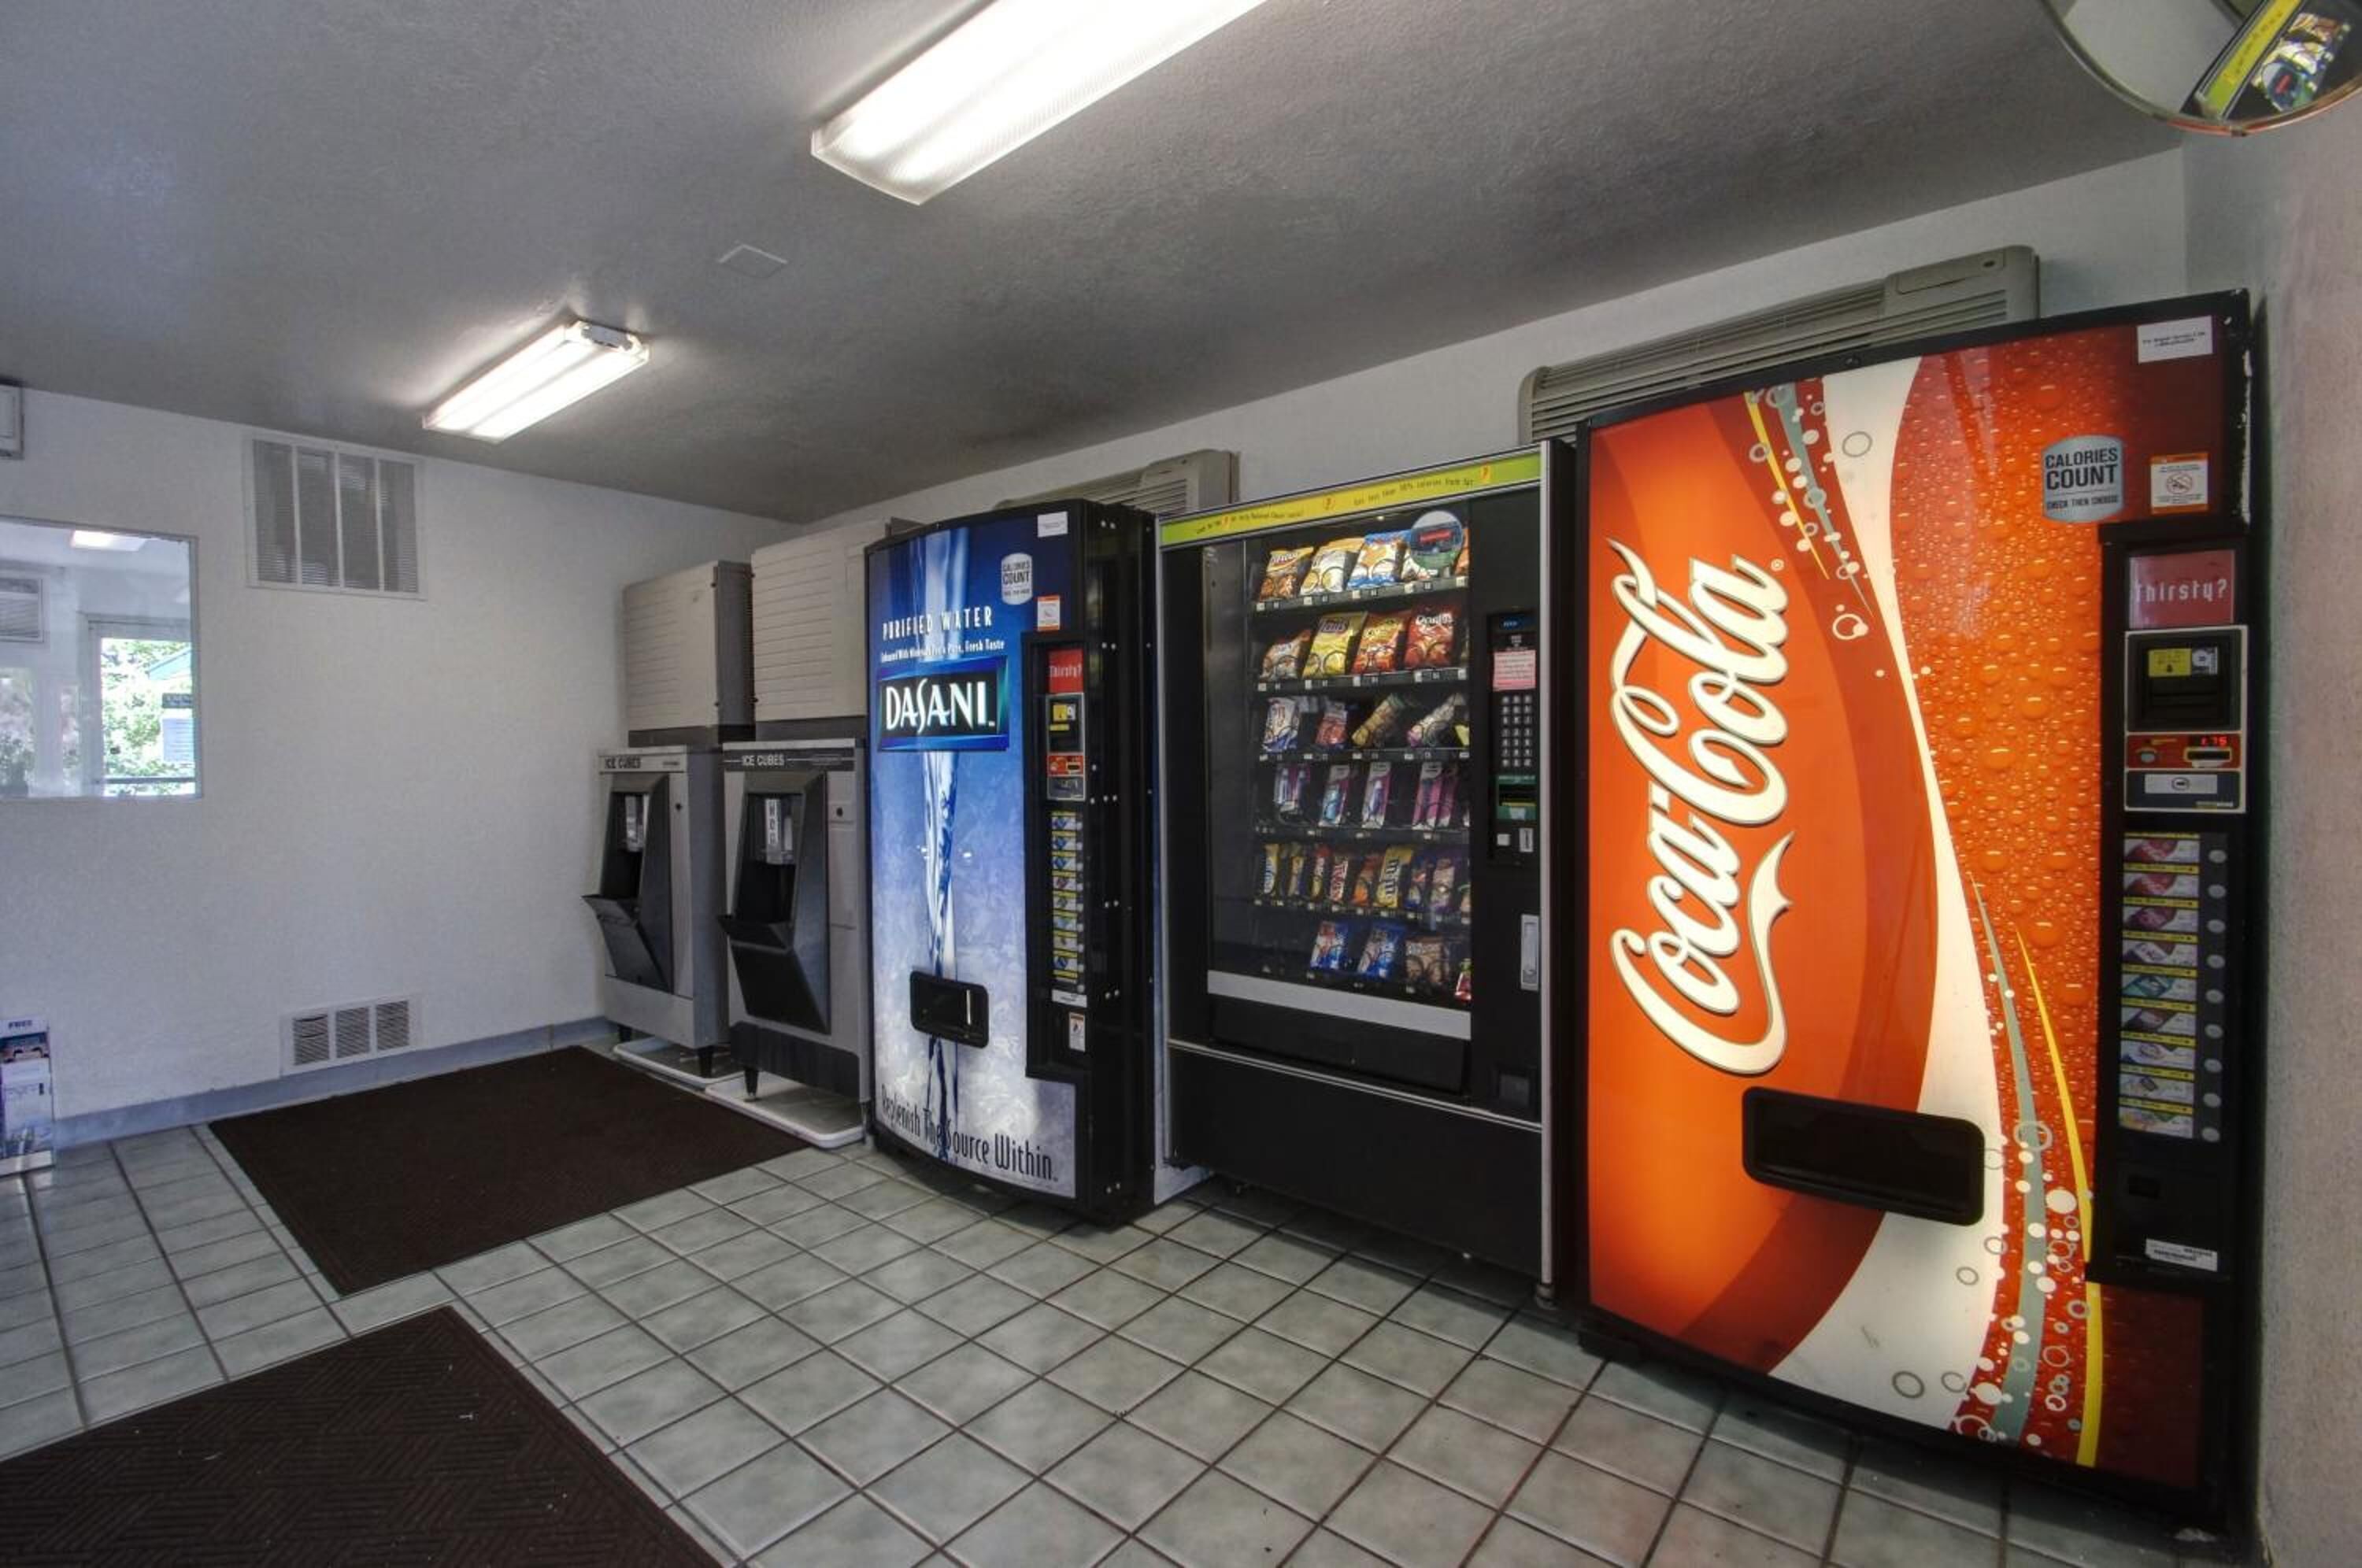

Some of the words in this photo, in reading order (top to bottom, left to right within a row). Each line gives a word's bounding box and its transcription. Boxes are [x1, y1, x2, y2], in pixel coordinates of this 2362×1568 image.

[2045, 448, 2118, 469] CALORIES
[2047, 464, 2119, 490] COUNT
[1002, 571, 1030, 586] COUNT
[2134, 578, 2227, 603] thirsty?
[882, 613, 933, 641] PURIFIED
[941, 605, 993, 631] WATER
[965, 639, 983, 653] Fresh
[985, 638, 1005, 650] Taste
[604, 757, 616, 769] ICE
[618, 756, 641, 769] CUBES
[742, 756, 755, 767] ICE
[757, 754, 785, 767] CUBES
[1607, 538, 1796, 1075] Coca-Cola
